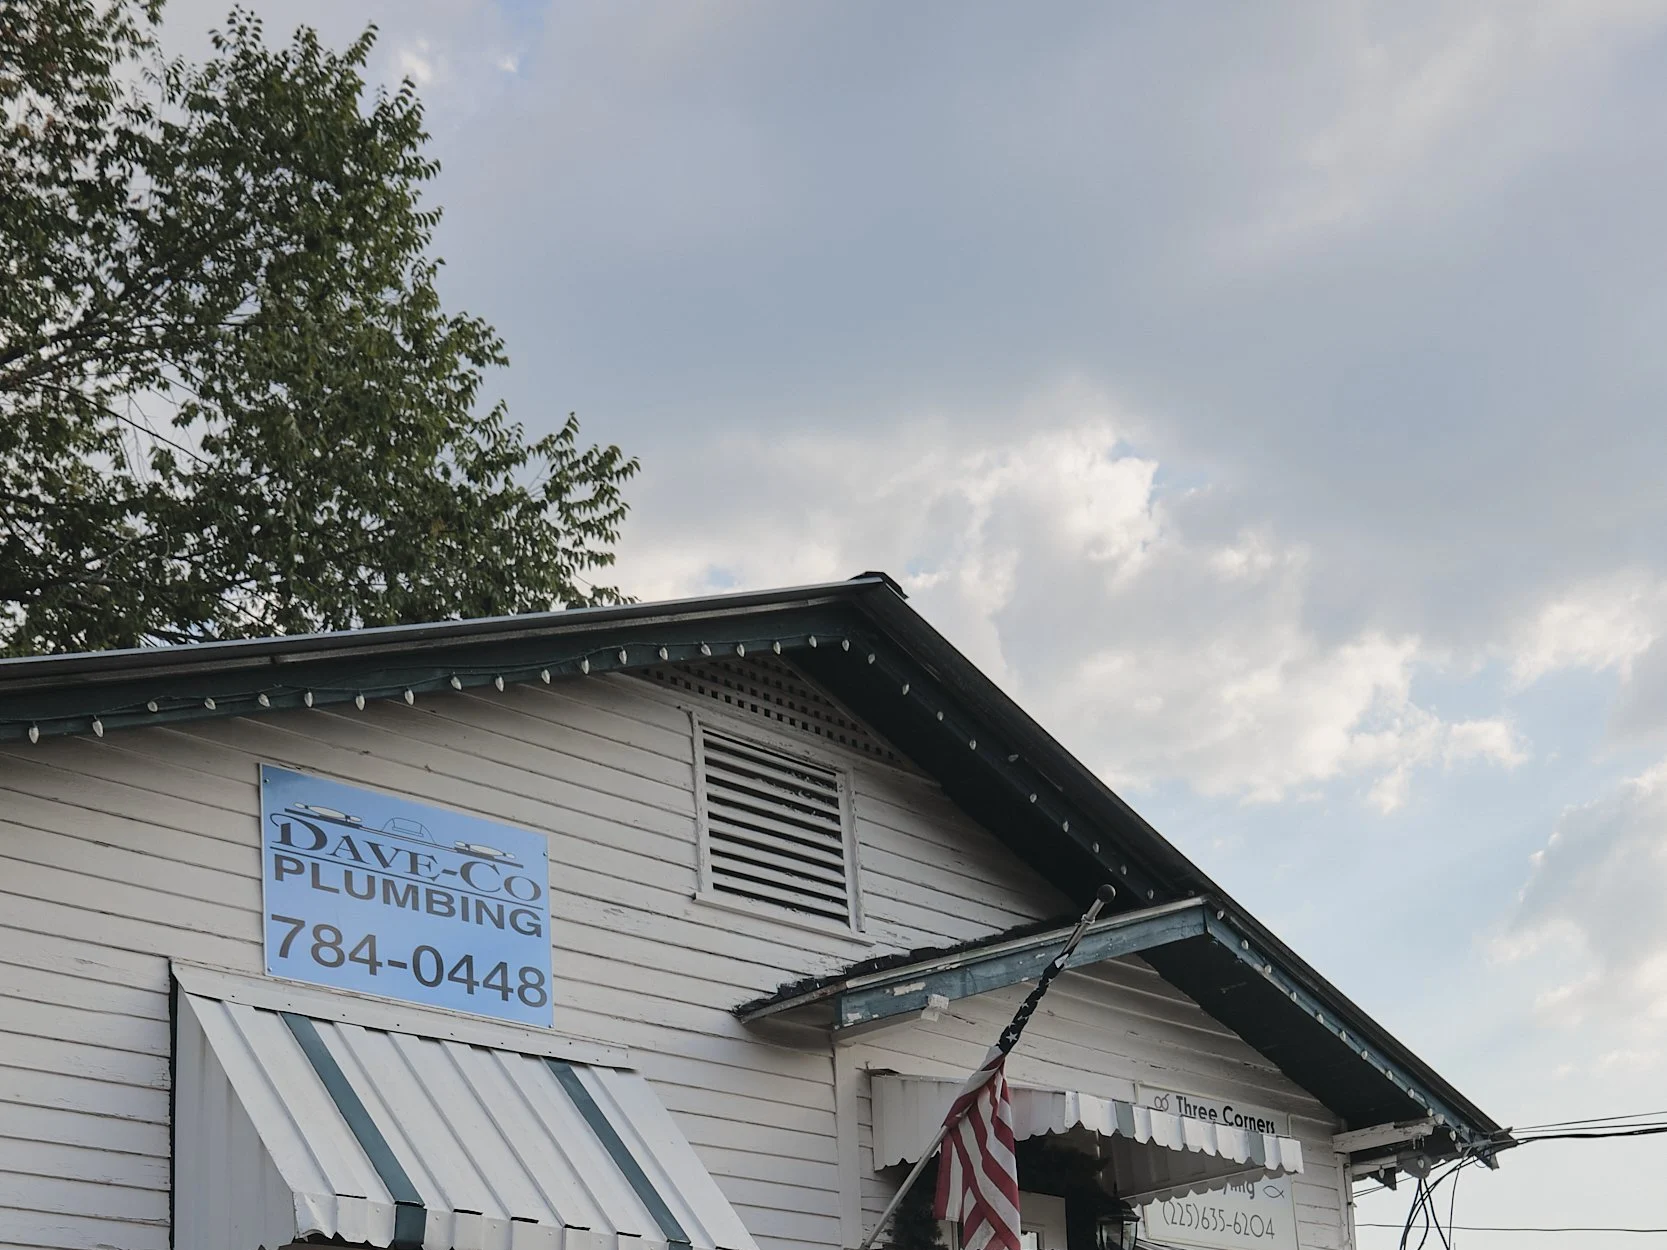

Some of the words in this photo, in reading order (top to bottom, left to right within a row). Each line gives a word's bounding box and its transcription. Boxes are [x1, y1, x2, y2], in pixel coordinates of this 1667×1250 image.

[269, 813, 542, 901] DAVE-CO
[274, 853, 543, 938] PLUMBING
[271, 914, 548, 1008] 784-0448
[1175, 1095, 1218, 1121] Three
[1222, 1105, 1276, 1134] Corners
[1162, 1200, 1275, 1239] (225)635-6204
